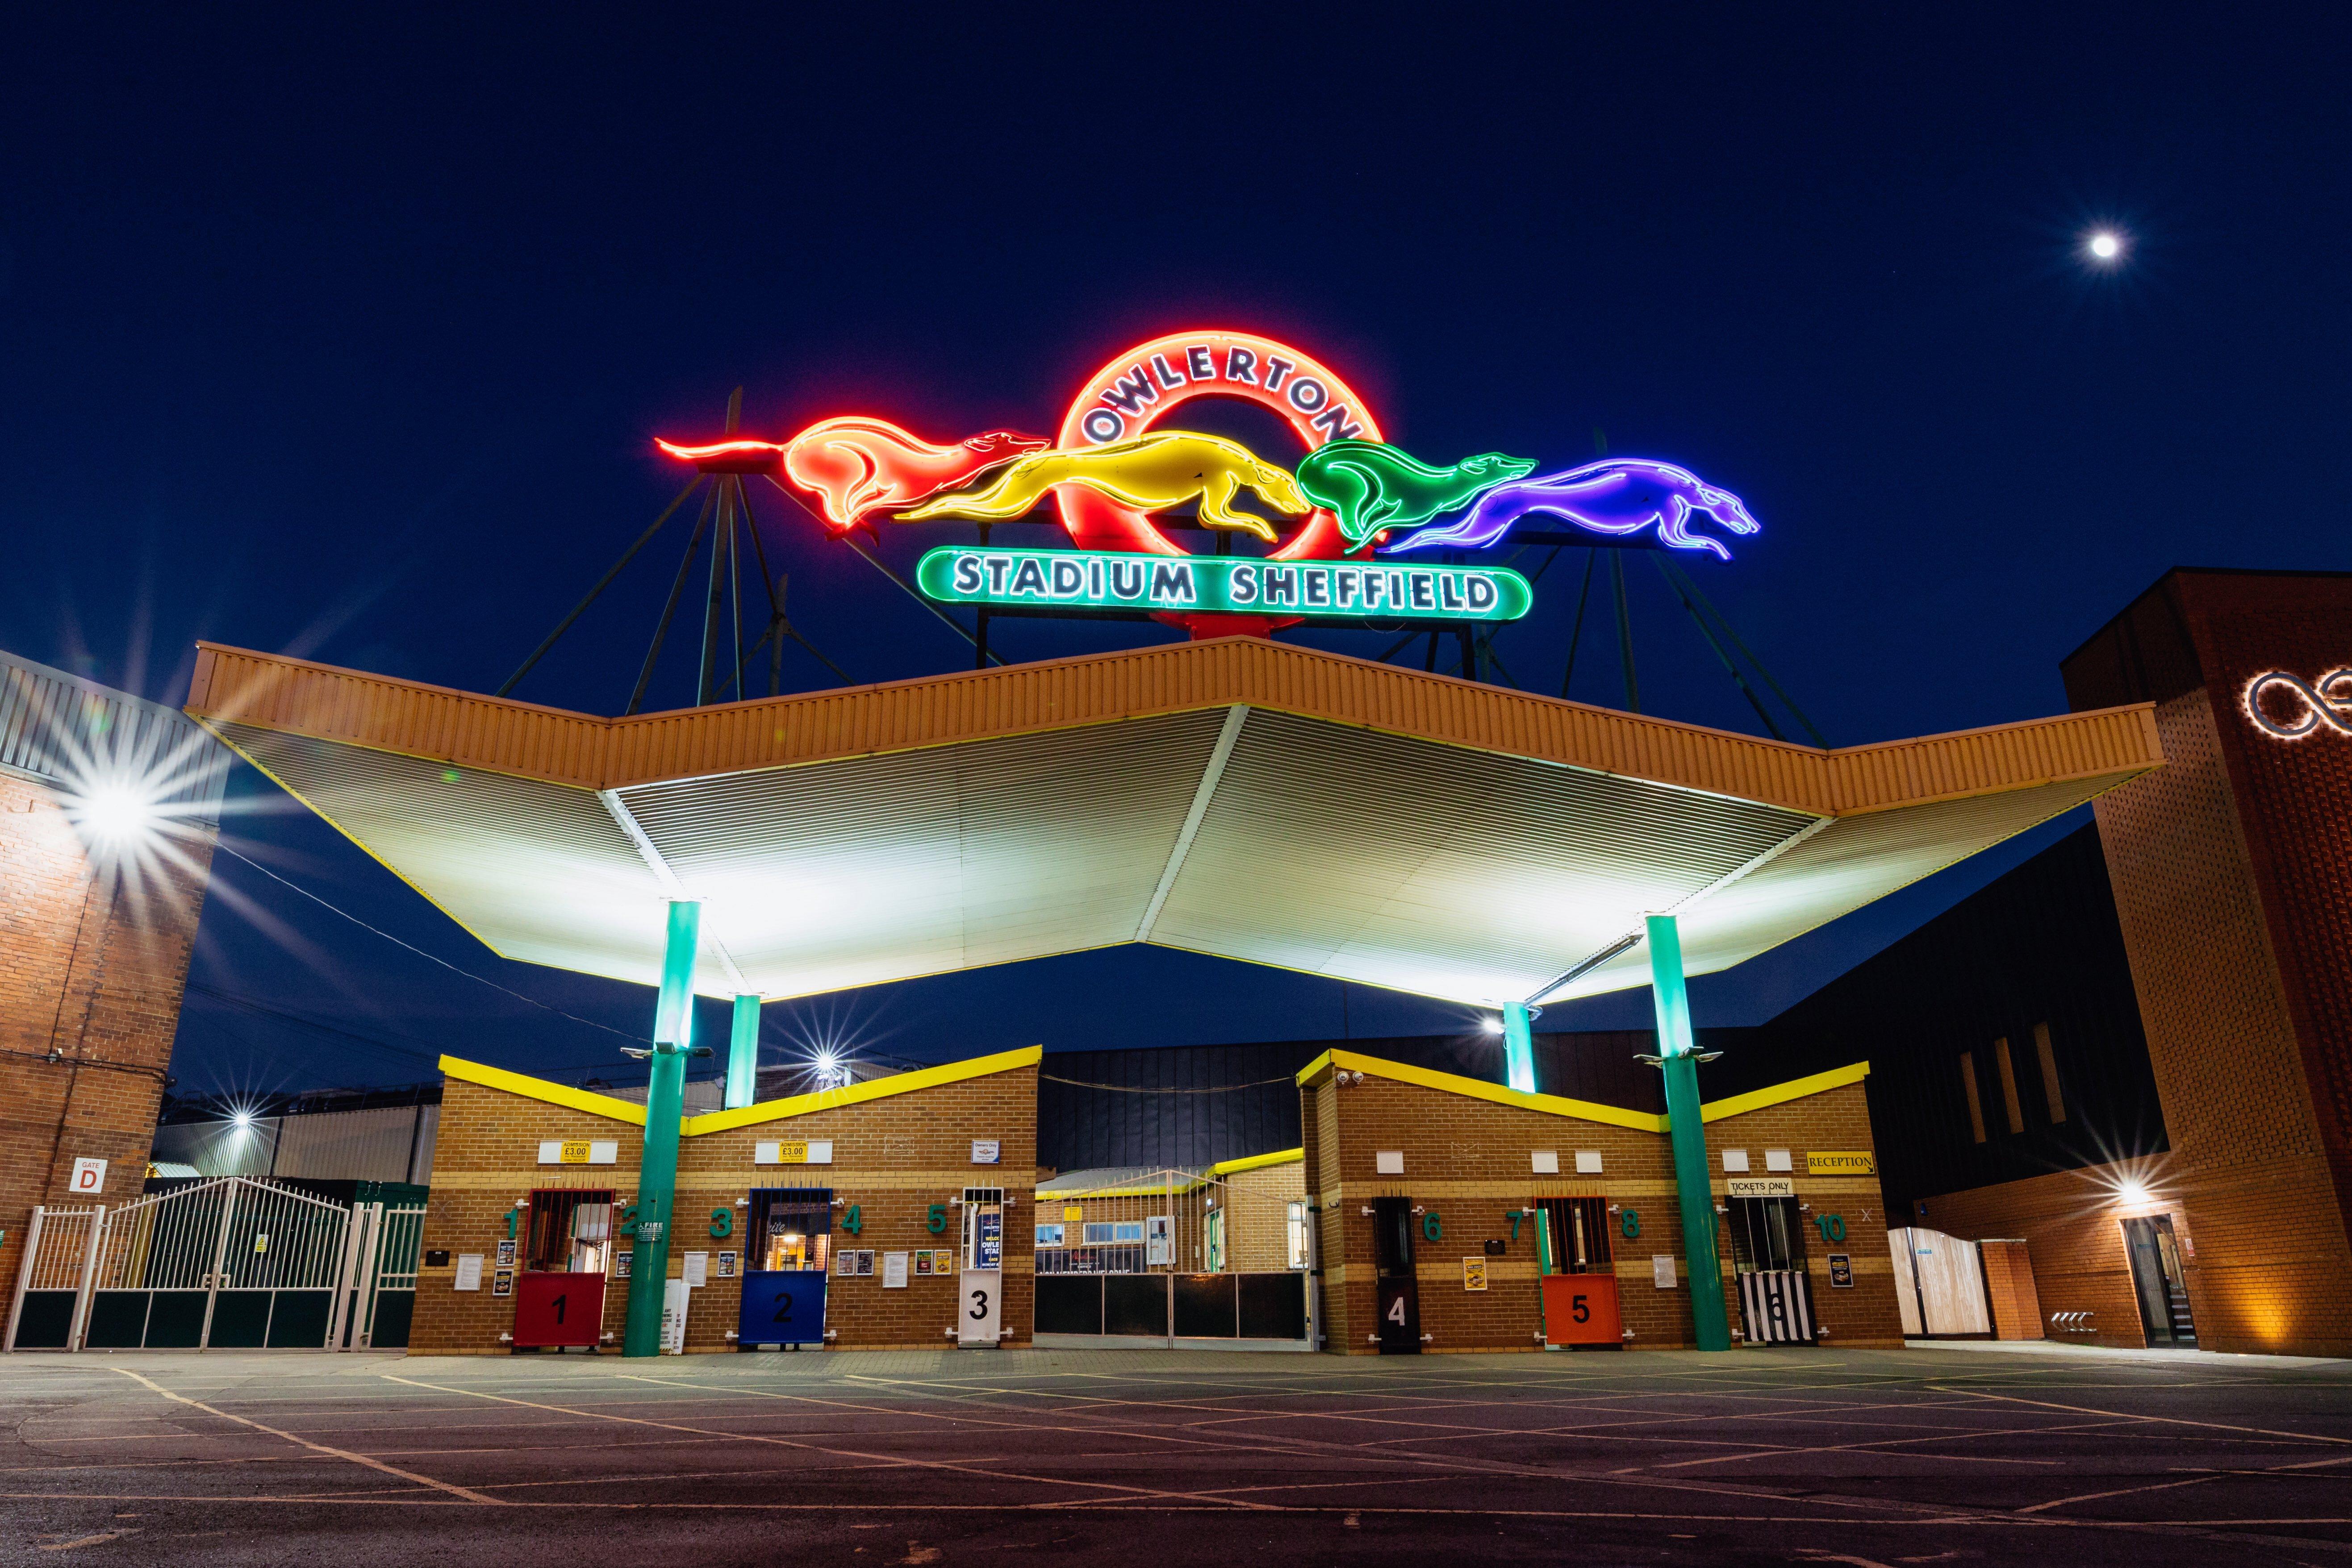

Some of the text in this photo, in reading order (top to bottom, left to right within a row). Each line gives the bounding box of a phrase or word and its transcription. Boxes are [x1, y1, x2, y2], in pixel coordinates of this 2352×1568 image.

[1082, 344, 1363, 443] OWLERTON
[953, 555, 1499, 612] STADIUM SHEFFIELD
[1809, 1157, 1872, 1167] RECEPTION
[79, 1170, 97, 1188] D
[504, 1208, 518, 1239] 1
[620, 1205, 637, 1234] 2
[709, 1208, 732, 1238] 3
[841, 1205, 862, 1234] 4
[927, 1204, 947, 1233] 5
[1424, 1213, 1442, 1241] 6
[1507, 1212, 1524, 1239] 7
[1621, 1209, 1640, 1238] 8
[1814, 1214, 1847, 1242] 10
[551, 1295, 566, 1324] 1
[773, 1293, 793, 1322] 2
[969, 1290, 988, 1320] 3
[1388, 1297, 1405, 1325] 4
[1572, 1295, 1590, 1324] 5
[1770, 1293, 1783, 1321] 6
